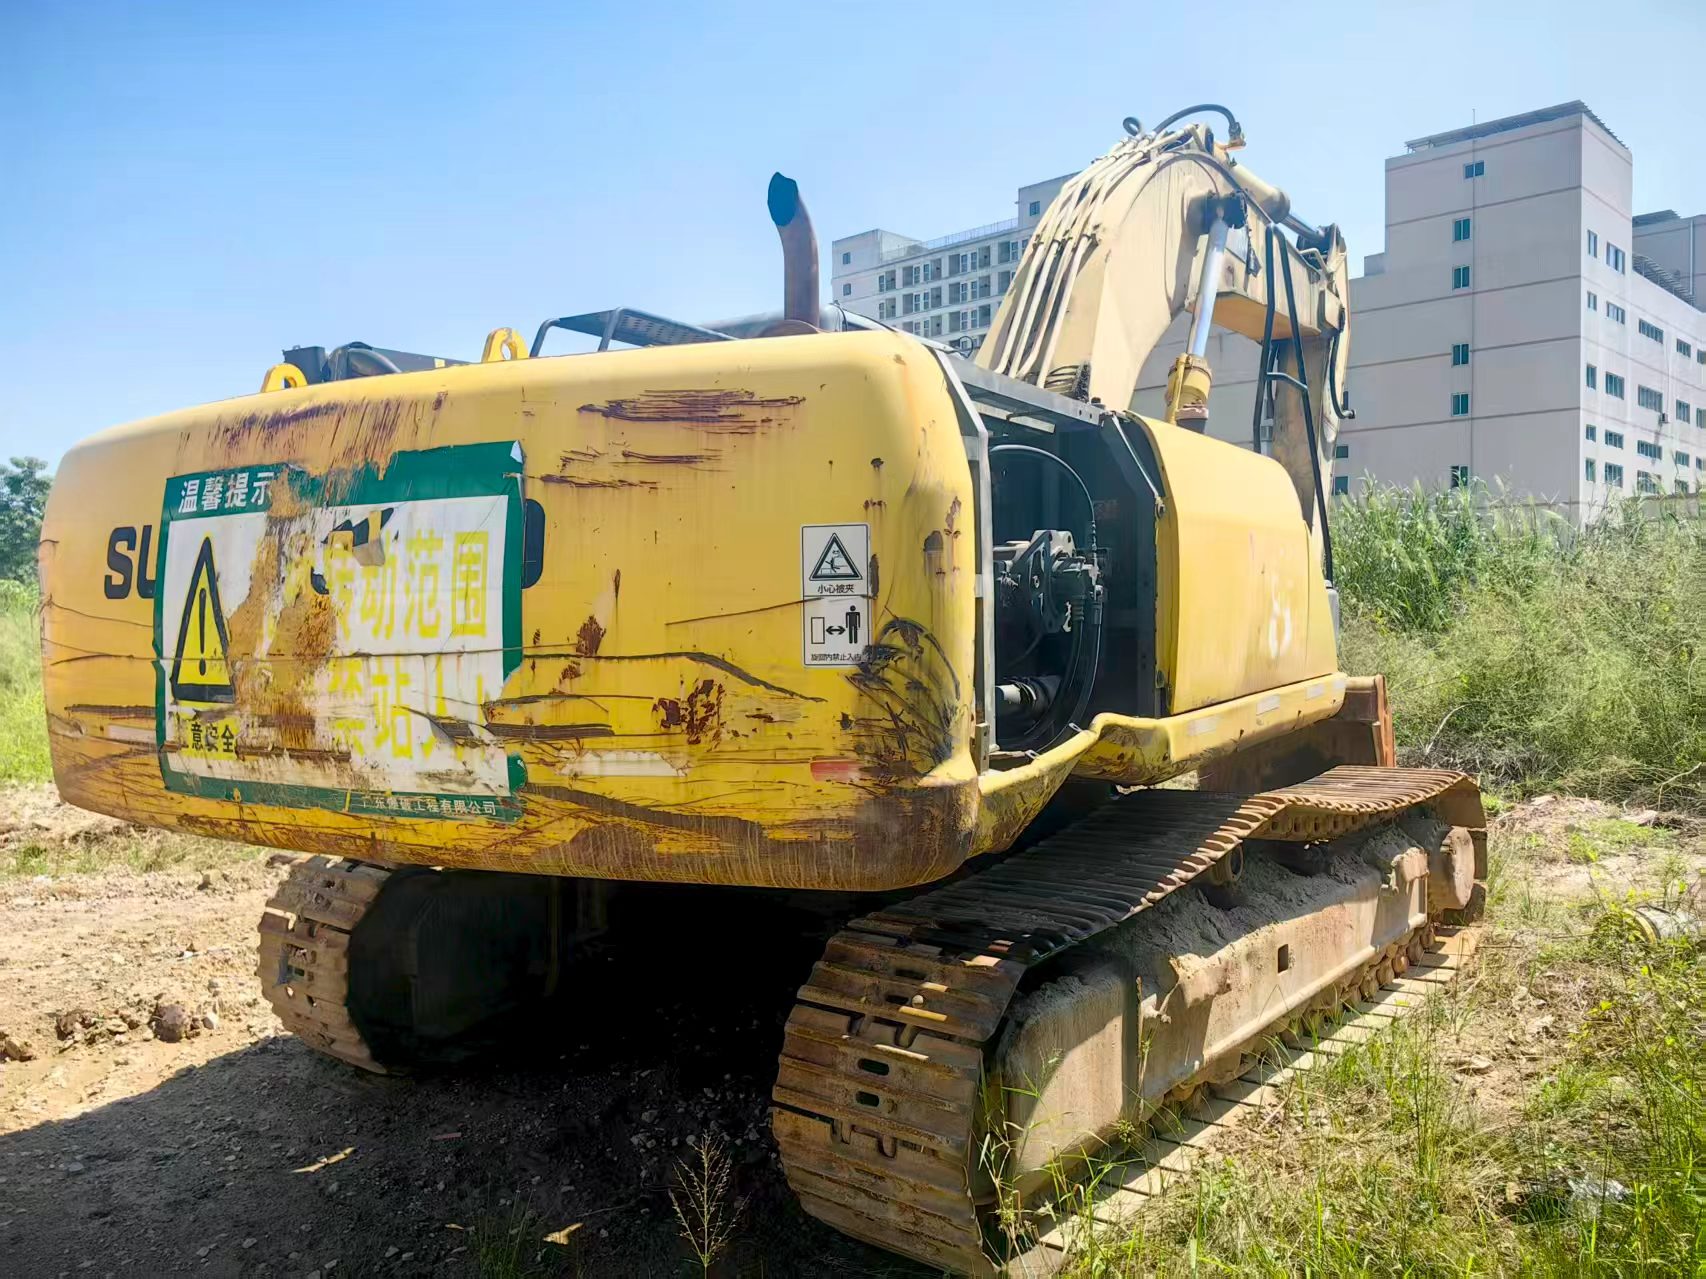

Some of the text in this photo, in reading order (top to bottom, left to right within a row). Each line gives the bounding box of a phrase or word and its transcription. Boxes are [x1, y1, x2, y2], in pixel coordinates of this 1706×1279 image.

[179, 472, 274, 513] 温馨提示
[817, 584, 855, 594] 小心被夹
[176, 720, 235, 753] 意安全
